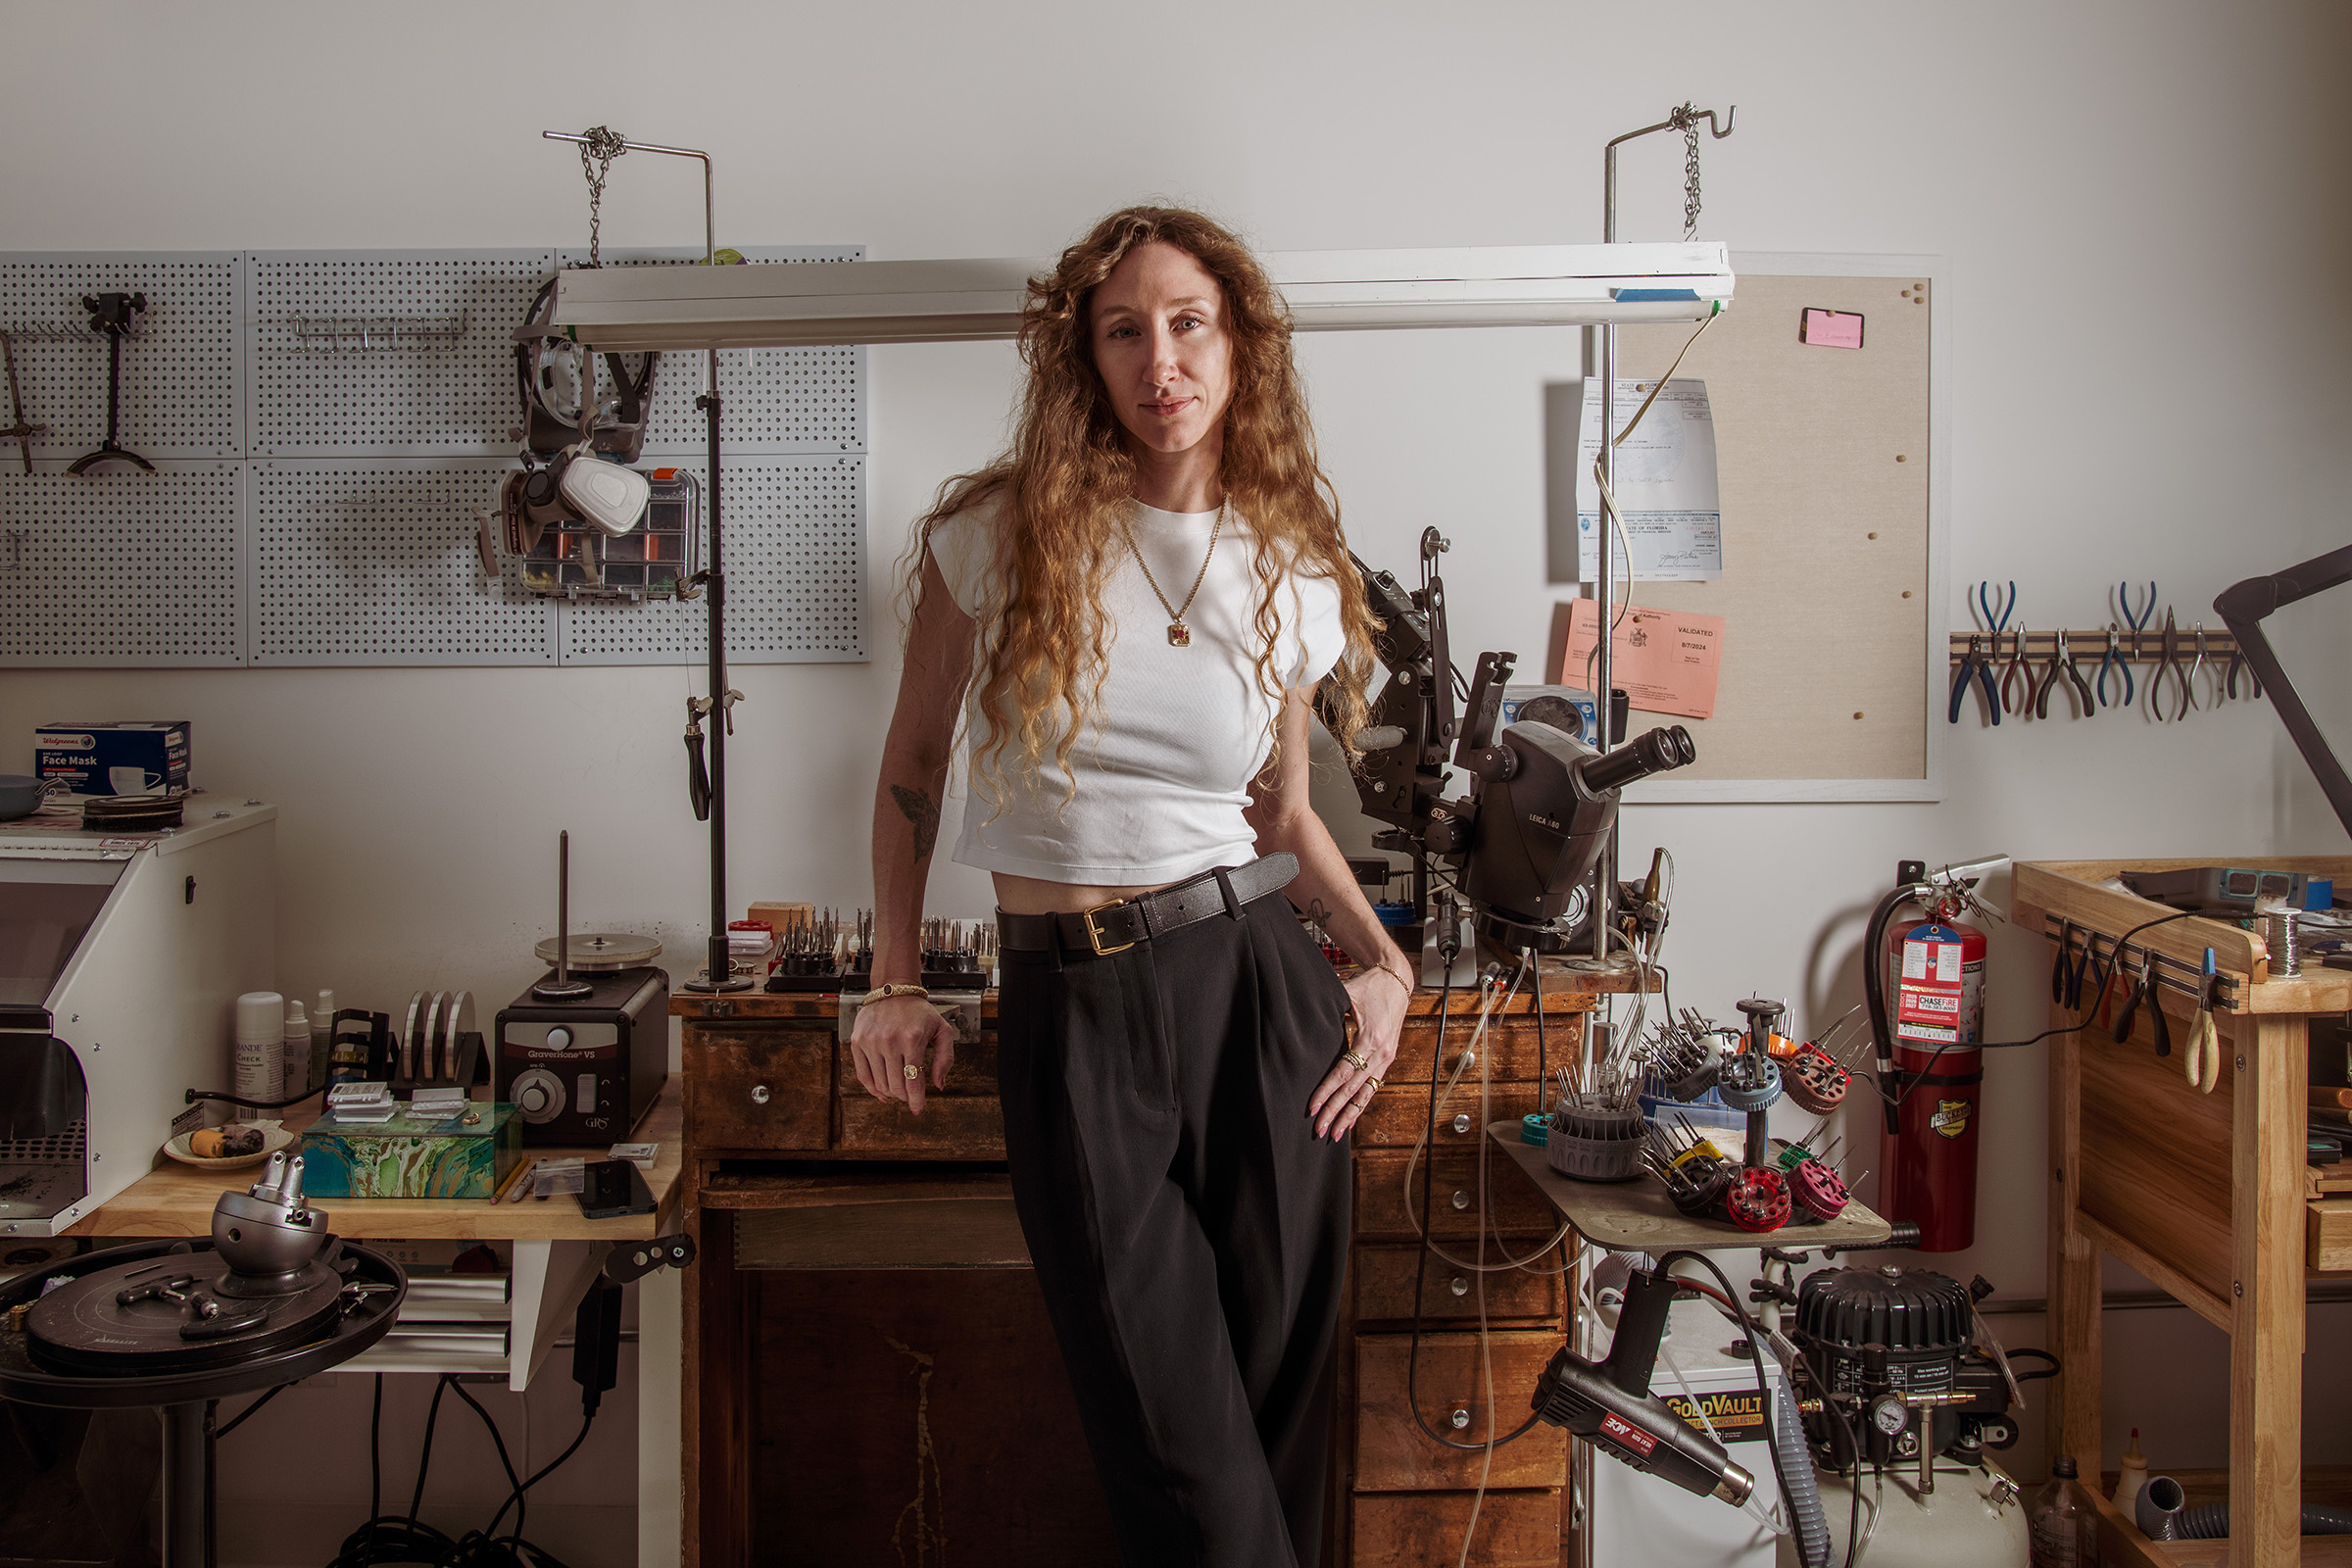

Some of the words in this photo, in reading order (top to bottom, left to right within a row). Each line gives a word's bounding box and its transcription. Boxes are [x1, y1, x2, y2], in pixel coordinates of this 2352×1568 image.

[1678, 627, 1713, 637] VALIDATED
[1681, 642, 1706, 650] 8/7/2024
[43, 737, 79, 746] Walgreens
[43, 756, 67, 765] Face
[69, 756, 97, 765] Mask
[1529, 813, 1546, 825] LEICA
[1936, 1106, 1968, 1122] BUCKEYE
[1605, 1417, 1631, 1435] ACE
[1631, 1433, 1642, 1442] GUN
[1640, 1438, 1653, 1449] HEAT
